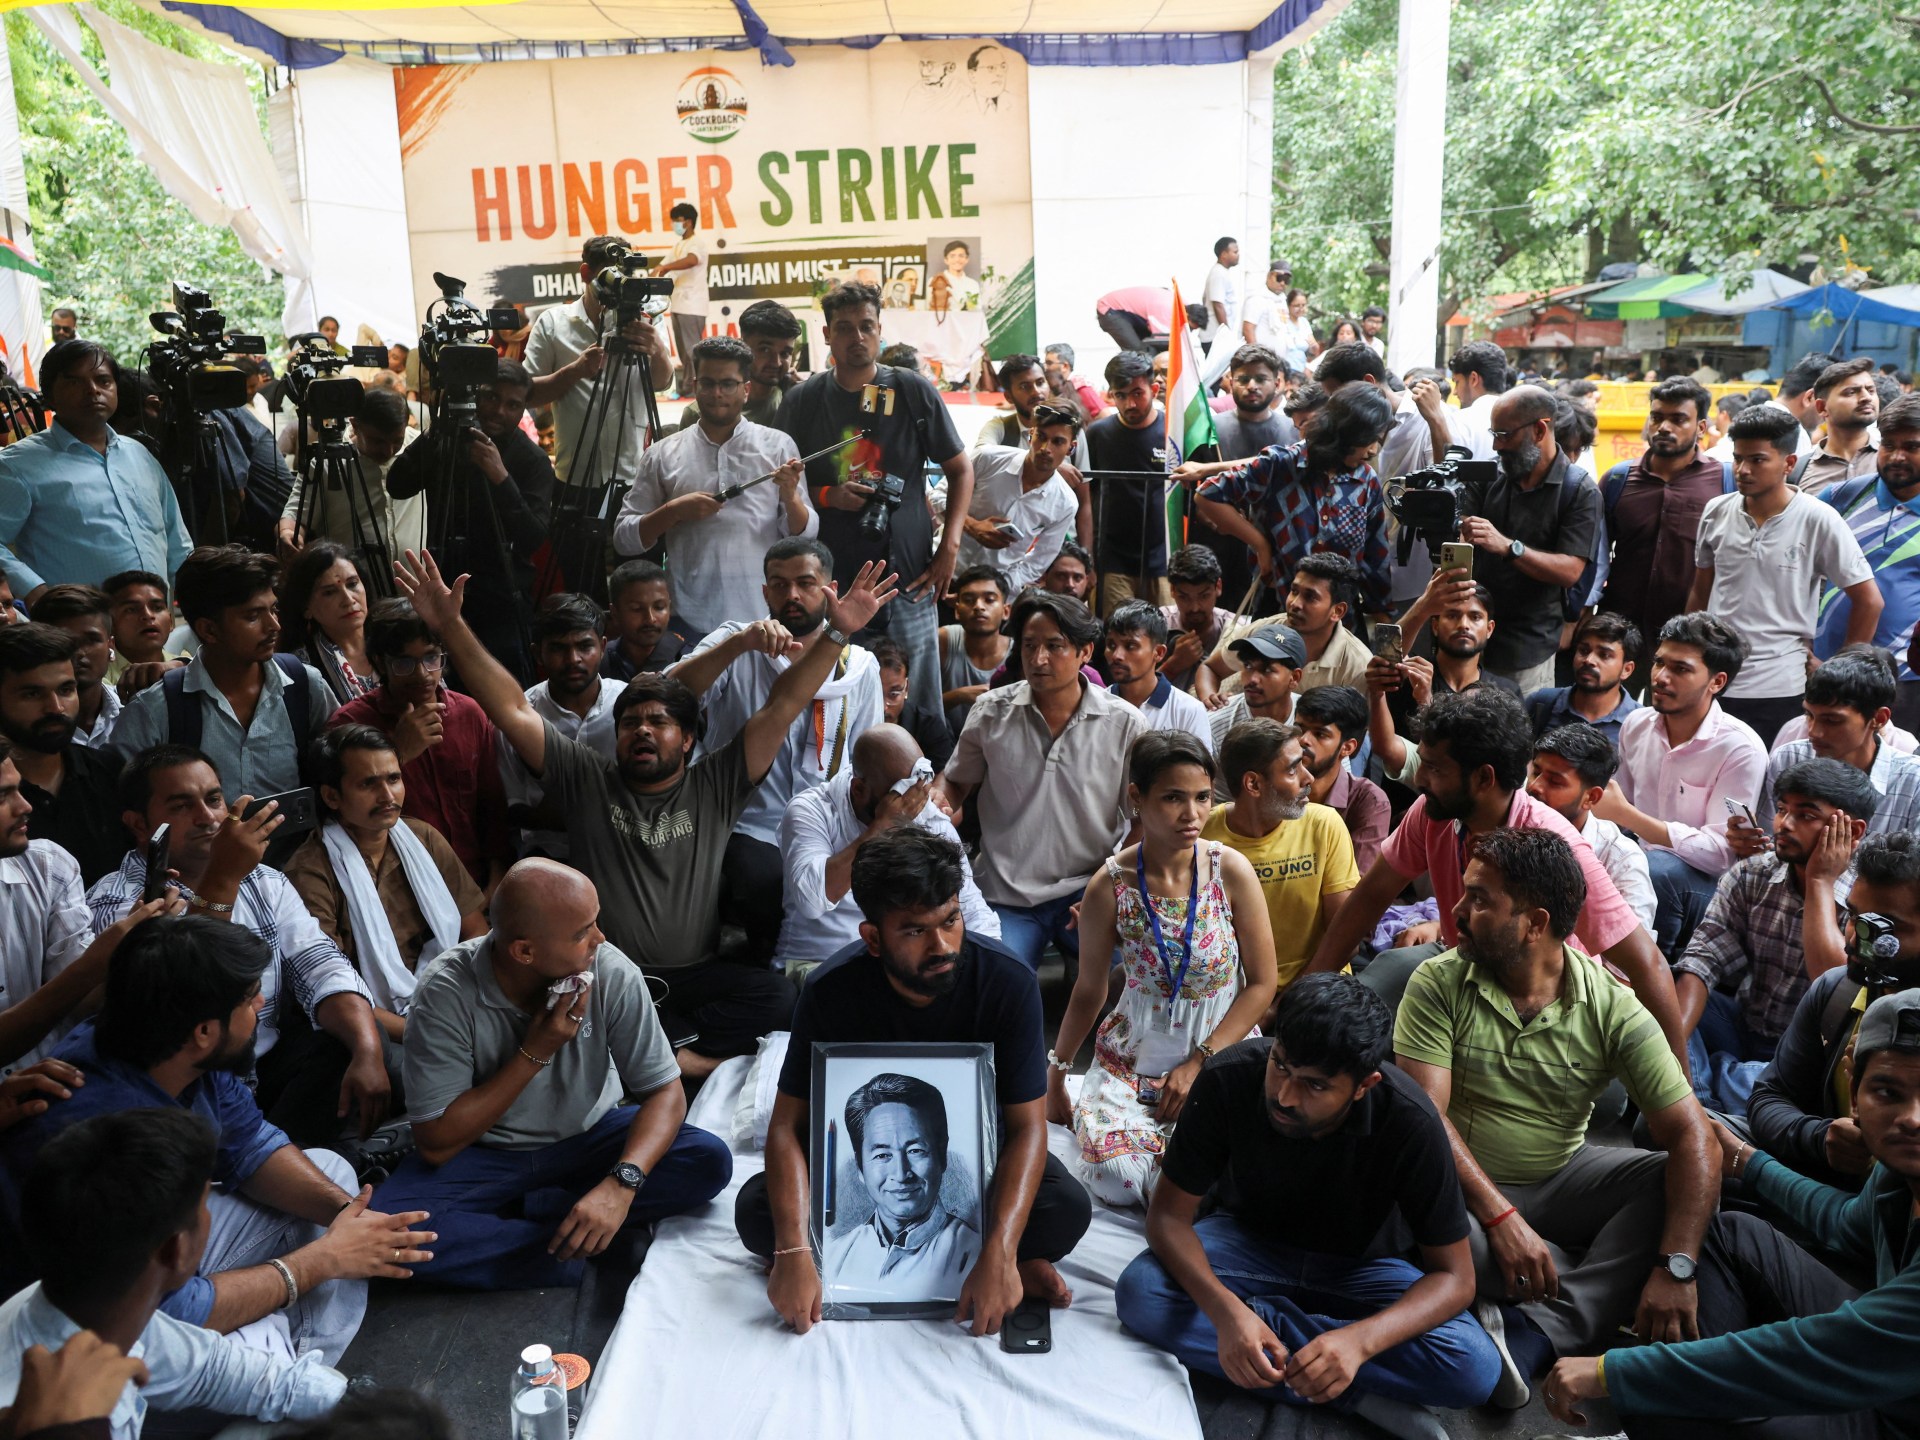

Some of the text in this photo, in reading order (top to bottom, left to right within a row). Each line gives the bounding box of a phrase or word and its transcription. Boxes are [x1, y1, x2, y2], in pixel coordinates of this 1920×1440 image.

[689, 114, 738, 126] COCKROACH
[471, 143, 980, 243] HUNGER STRIKE
[708, 261, 781, 288] ADHAN
[641, 822, 693, 846] SURFING
[1254, 860, 1312, 878] RO UNO
